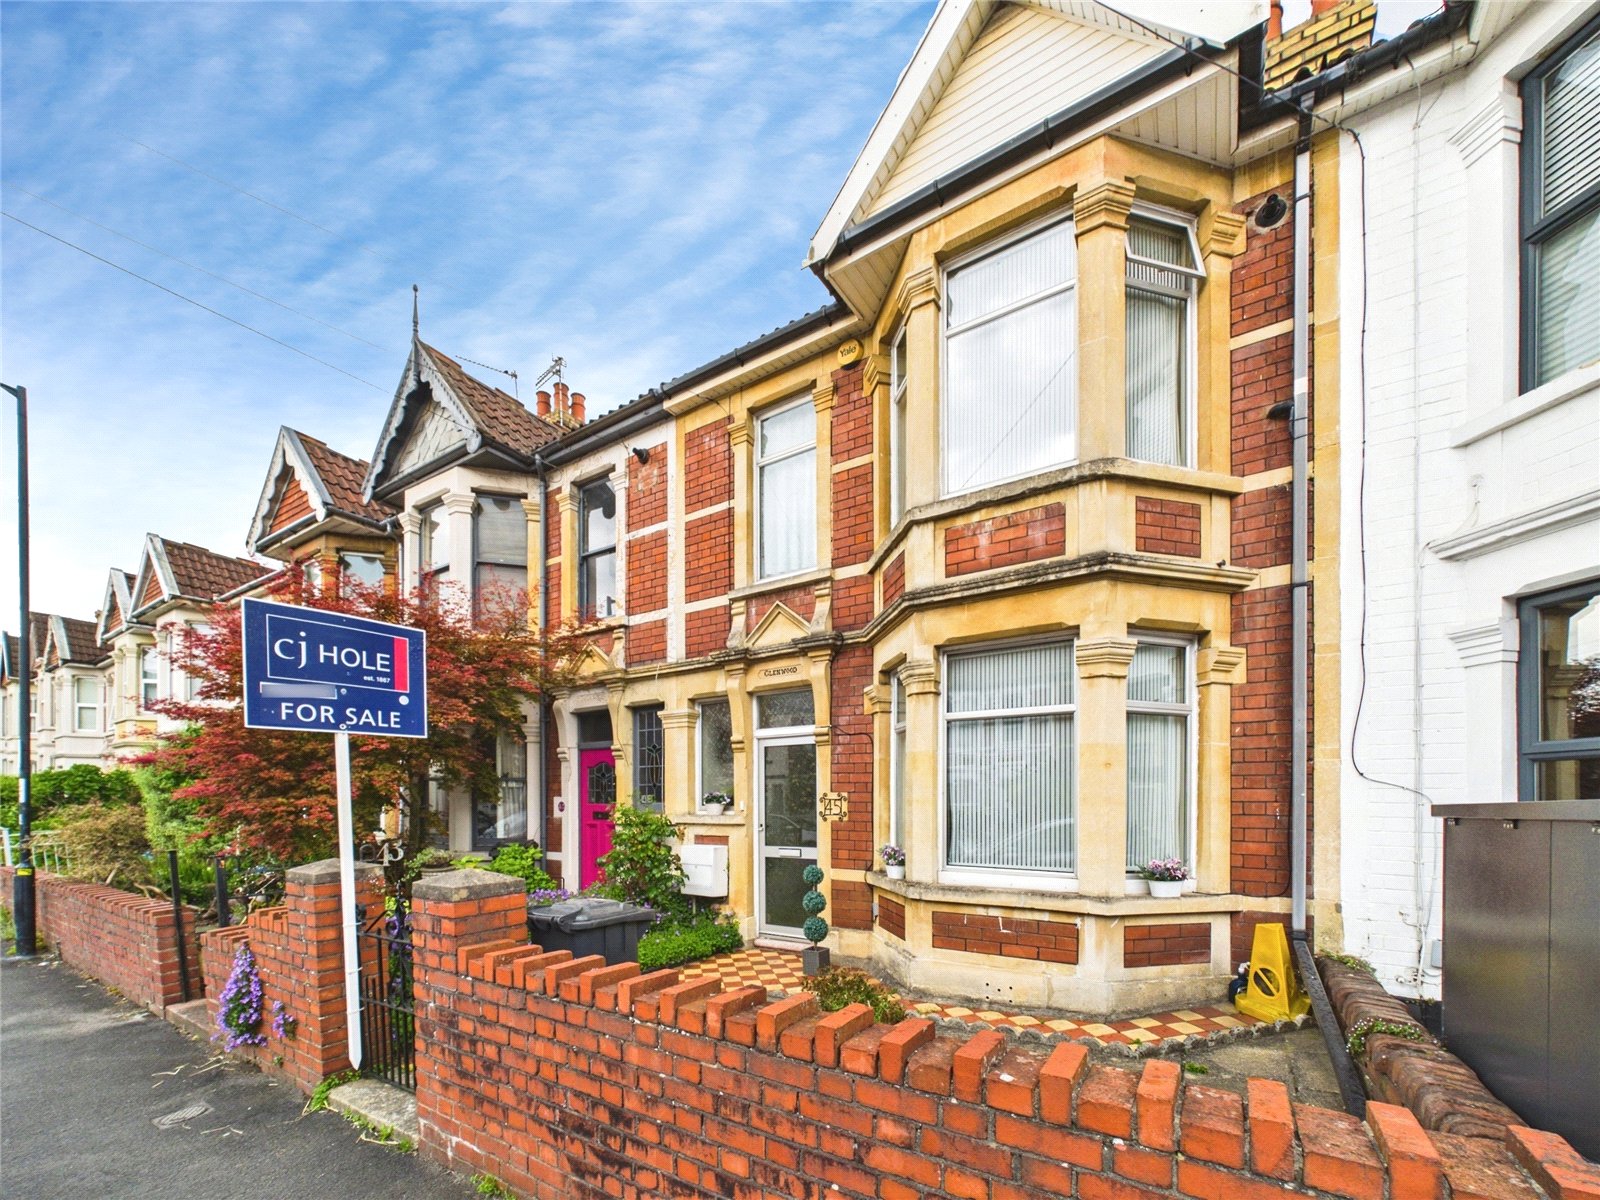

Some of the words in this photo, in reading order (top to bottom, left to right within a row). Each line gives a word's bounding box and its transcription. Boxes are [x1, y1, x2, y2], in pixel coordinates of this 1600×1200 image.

[839, 345, 857, 358] Yale
[319, 643, 391, 672] HOLE
[281, 702, 336, 724] FOR
[345, 707, 401, 728] SALE
[824, 798, 843, 816] 45
